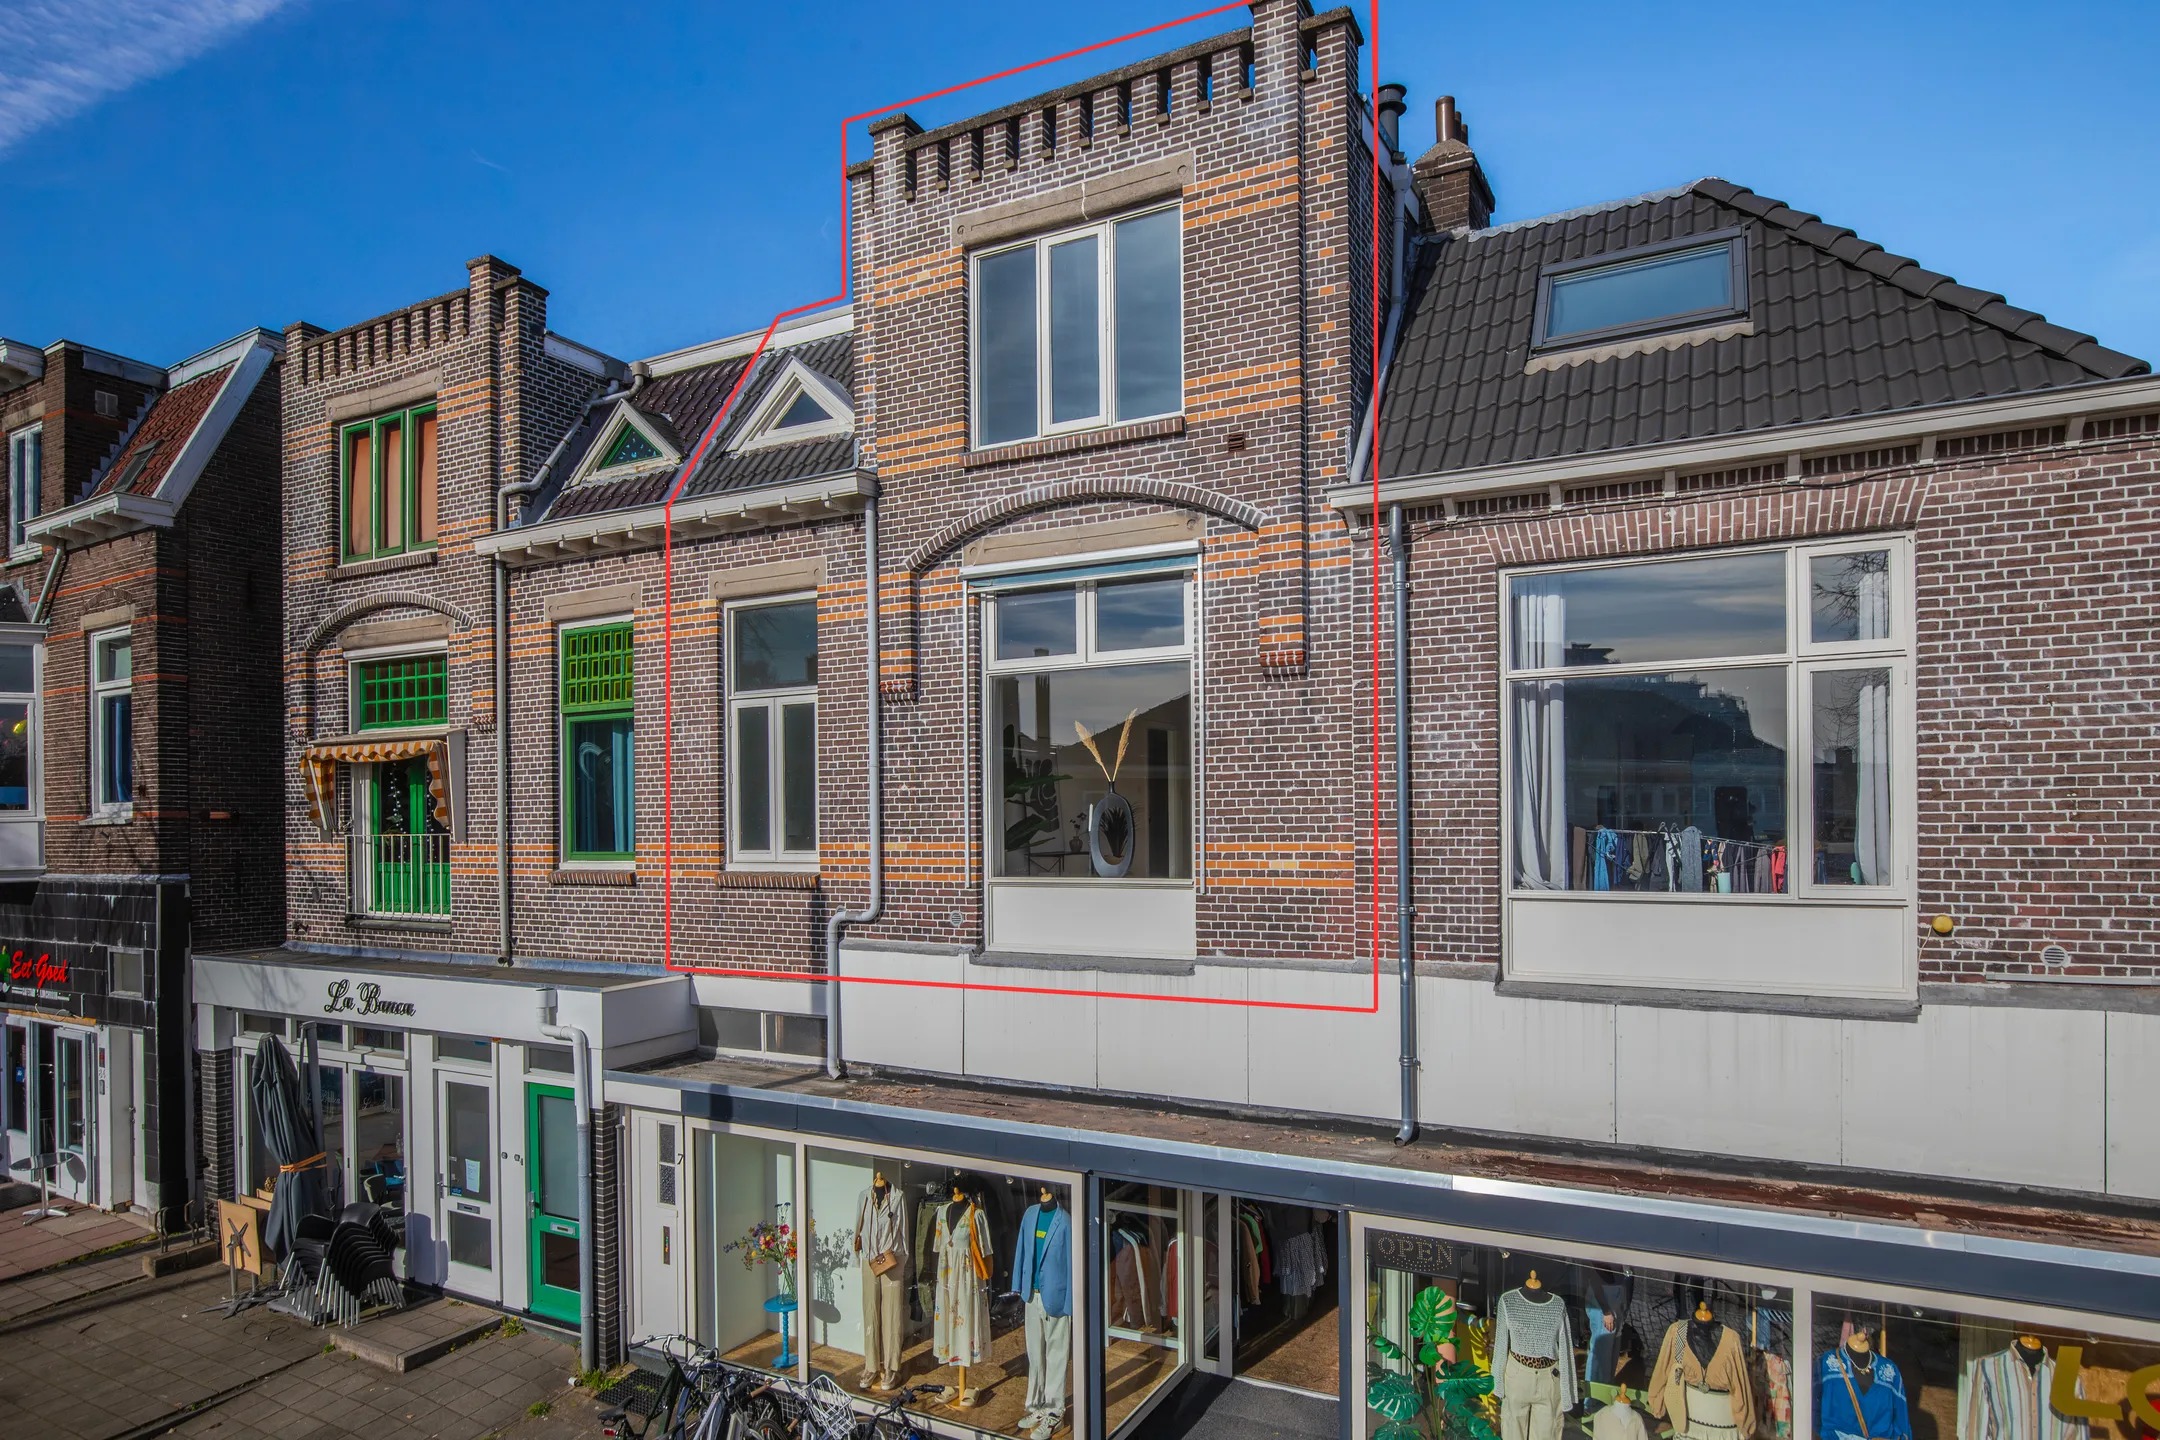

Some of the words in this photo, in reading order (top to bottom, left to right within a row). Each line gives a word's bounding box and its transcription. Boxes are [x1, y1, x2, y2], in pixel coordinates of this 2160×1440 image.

[11, 950, 32, 979] Eet
[35, 953, 67, 988] Goed
[324, 979, 355, 1013] La
[677, 1153, 684, 1165] 7
[1378, 1237, 1453, 1264] OPEN
